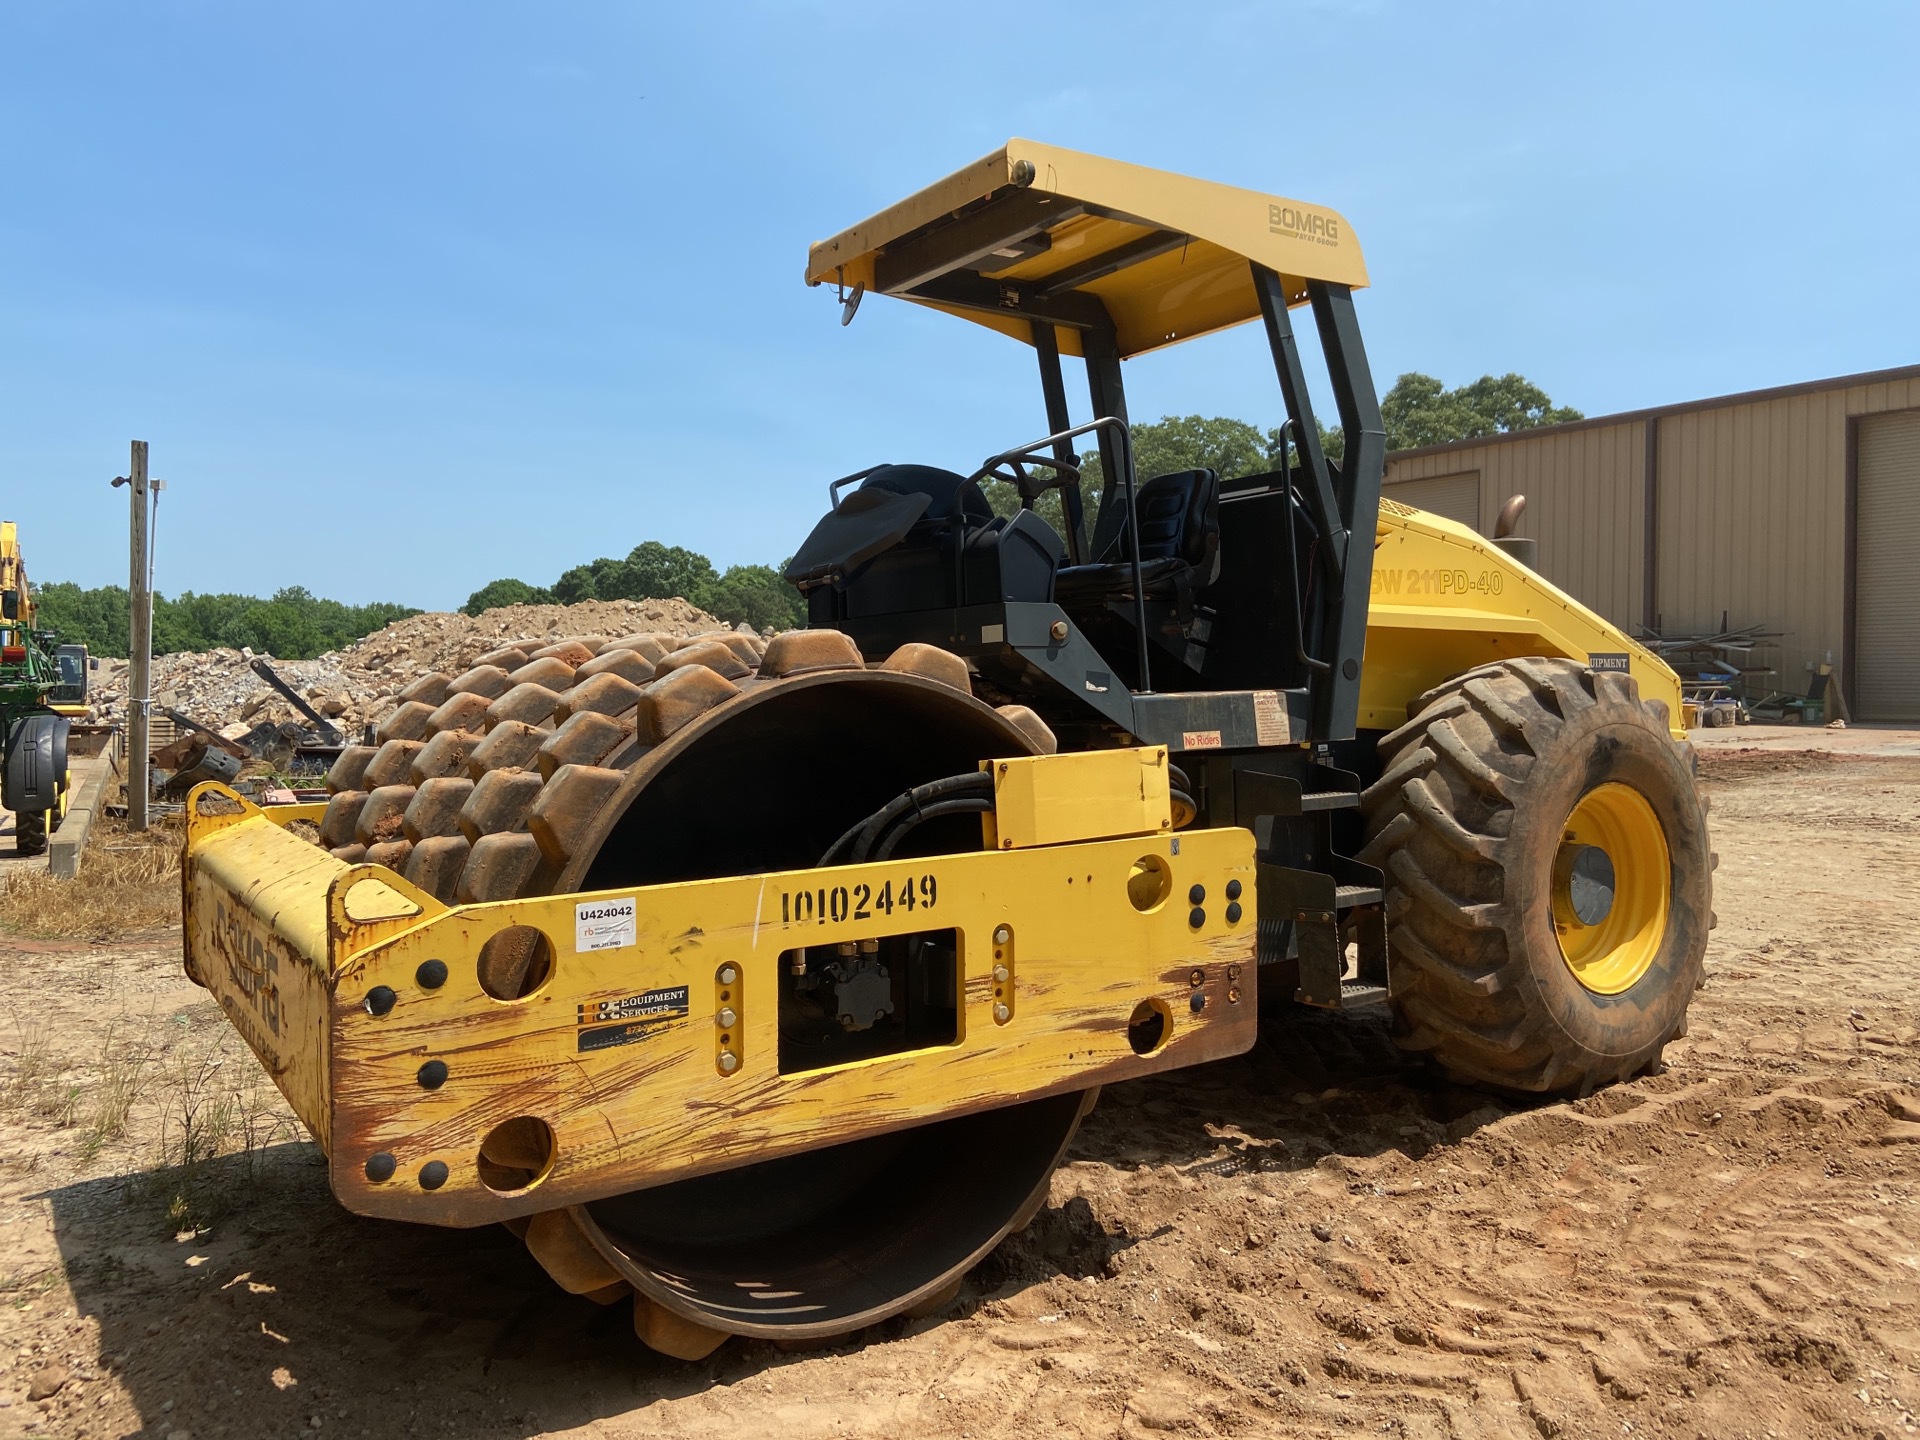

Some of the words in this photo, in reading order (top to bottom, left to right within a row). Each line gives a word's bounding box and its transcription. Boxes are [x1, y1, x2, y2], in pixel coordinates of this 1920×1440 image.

[1269, 204, 1338, 239] BOMAG
[1185, 736, 1196, 746] No
[1197, 734, 1219, 746] Riders
[580, 906, 632, 921] U424042
[620, 990, 685, 1008] EQUIPMENT
[620, 1004, 669, 1019] SERVICES
